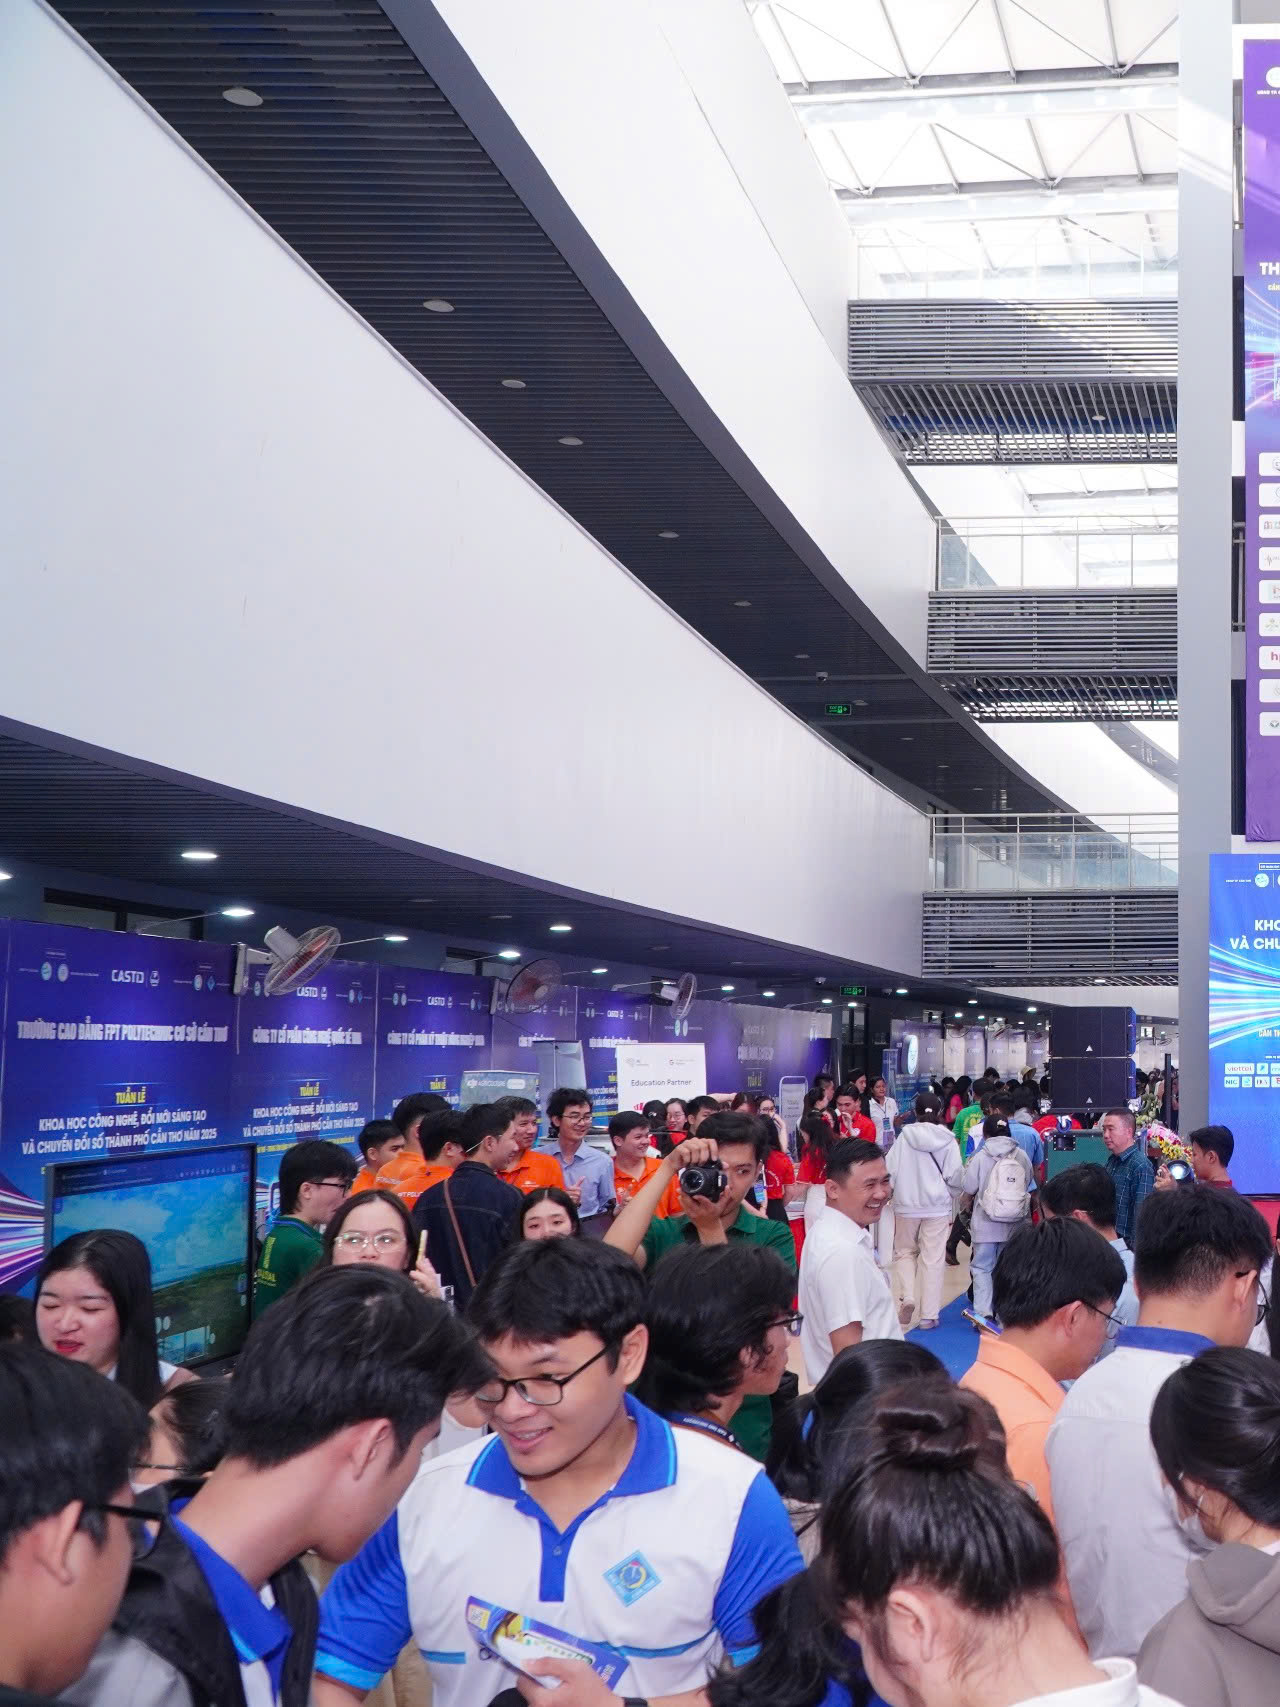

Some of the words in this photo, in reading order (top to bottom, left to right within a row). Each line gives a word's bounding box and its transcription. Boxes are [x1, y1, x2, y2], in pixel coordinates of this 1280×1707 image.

[1230, 935, 1250, 949] VÀ
[104, 1024, 120, 1040] FPT
[39, 1118, 64, 1132] KHOA
[66, 1116, 86, 1132] HỌC
[88, 1112, 114, 1129] CÔNG
[116, 1110, 139, 1128] NGHỆ,
[141, 1107, 154, 1124] ĐỔI
[156, 1109, 170, 1124] MỚI
[172, 1108, 192, 1122] SÁNG
[193, 1110, 206, 1124] TẠO
[22, 1138, 36, 1154] VÀ
[38, 1133, 72, 1153] CHUYỂN
[74, 1132, 90, 1150] ĐỔI
[92, 1133, 104, 1148] SỐ
[105, 1132, 132, 1148] THÀNH
[134, 1129, 150, 1146] PHỐ
[151, 1128, 166, 1144] CẦN
[168, 1129, 182, 1142] THƠ
[184, 1128, 200, 1142] NĂM
[202, 1128, 216, 1140] 2025
